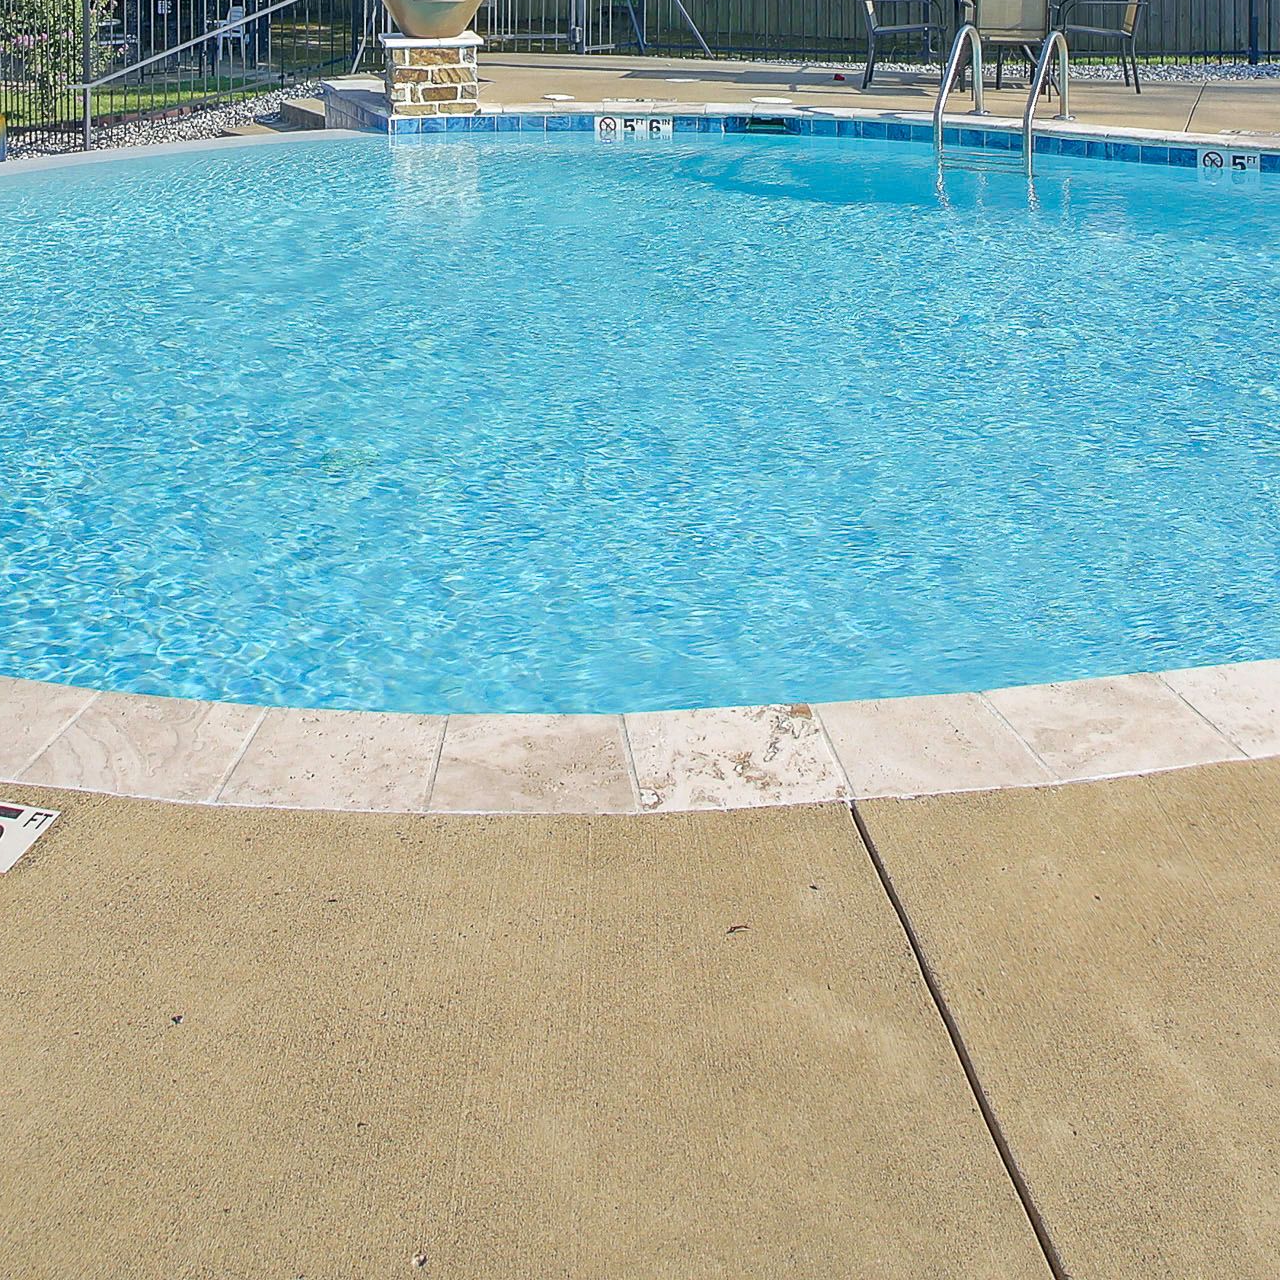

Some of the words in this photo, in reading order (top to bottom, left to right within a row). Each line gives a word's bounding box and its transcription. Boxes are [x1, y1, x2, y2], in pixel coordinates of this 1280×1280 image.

[624, 118, 636, 132] 5
[636, 118, 645, 126] FT
[649, 118, 661, 132] 6
[1232, 155, 1247, 170] 5
[1247, 156, 1257, 164] FT
[23, 811, 54, 830] FT
